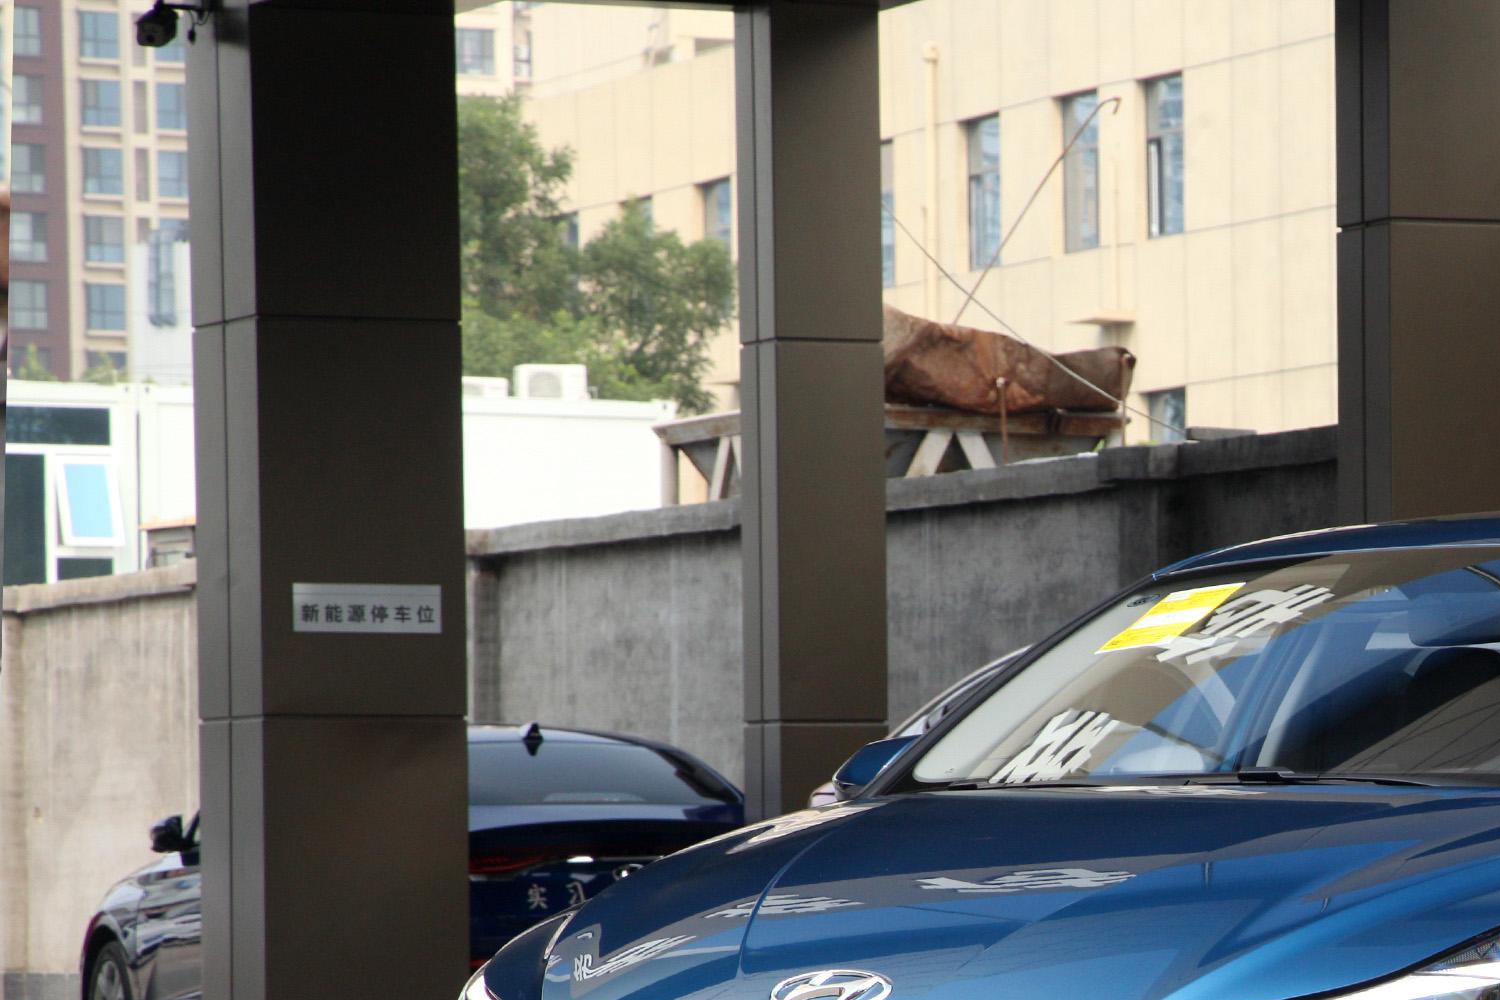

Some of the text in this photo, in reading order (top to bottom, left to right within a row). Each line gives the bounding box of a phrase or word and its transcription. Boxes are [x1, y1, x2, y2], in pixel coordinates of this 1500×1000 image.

[301, 604, 435, 623] 新能源停车位
